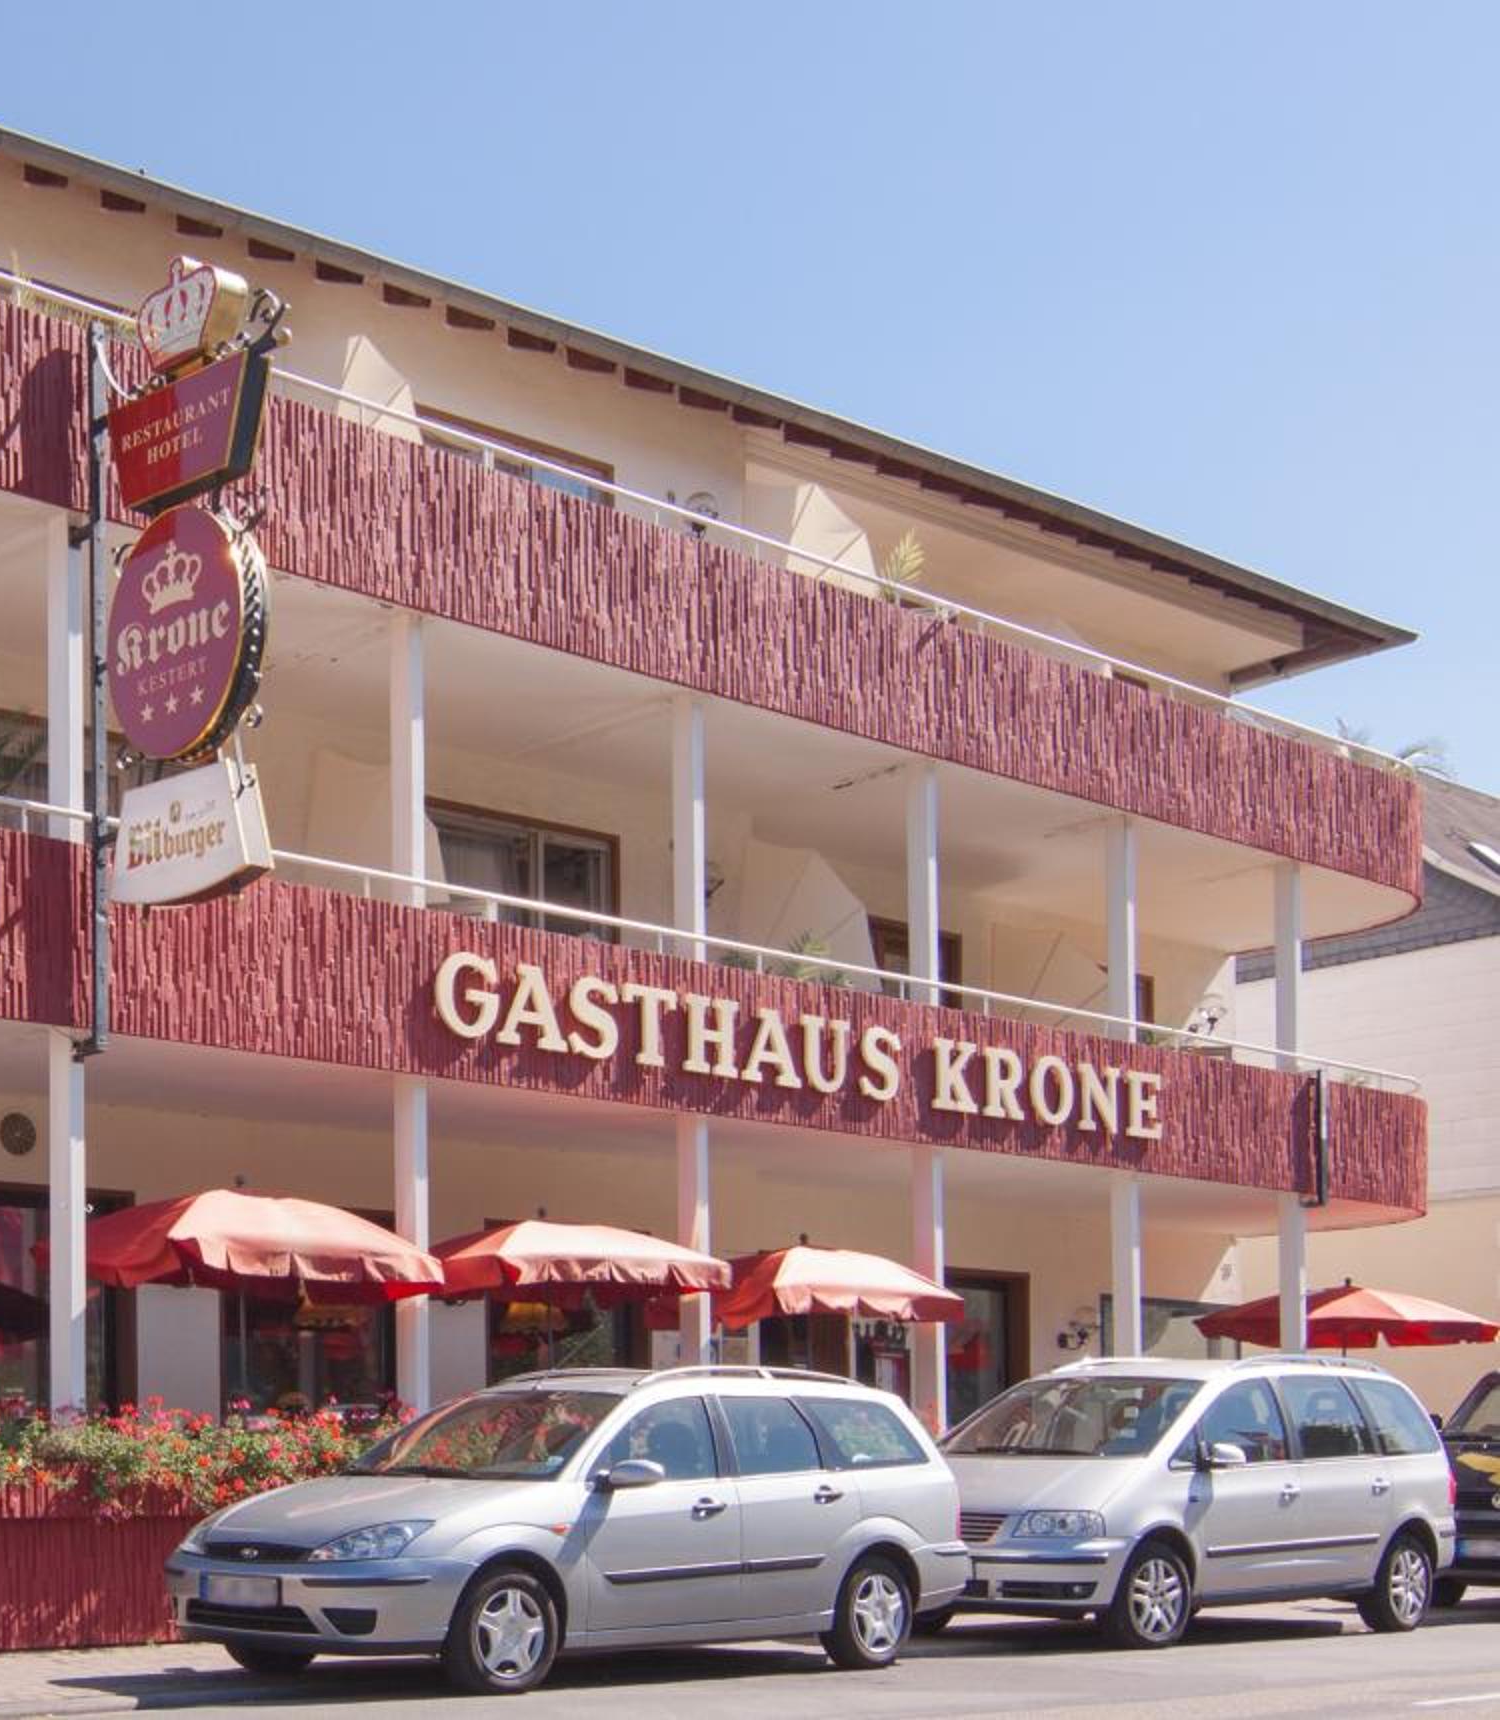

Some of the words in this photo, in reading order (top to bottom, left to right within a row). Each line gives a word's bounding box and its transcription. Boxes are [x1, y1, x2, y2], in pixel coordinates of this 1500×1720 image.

[121, 384, 232, 453] RESTAURANT
[147, 426, 203, 465] HOTEL
[116, 599, 230, 676] Krone
[138, 656, 207, 696] KESTERT
[435, 951, 901, 1102] GASTHAUS
[931, 1037, 1163, 1140] KRONE
